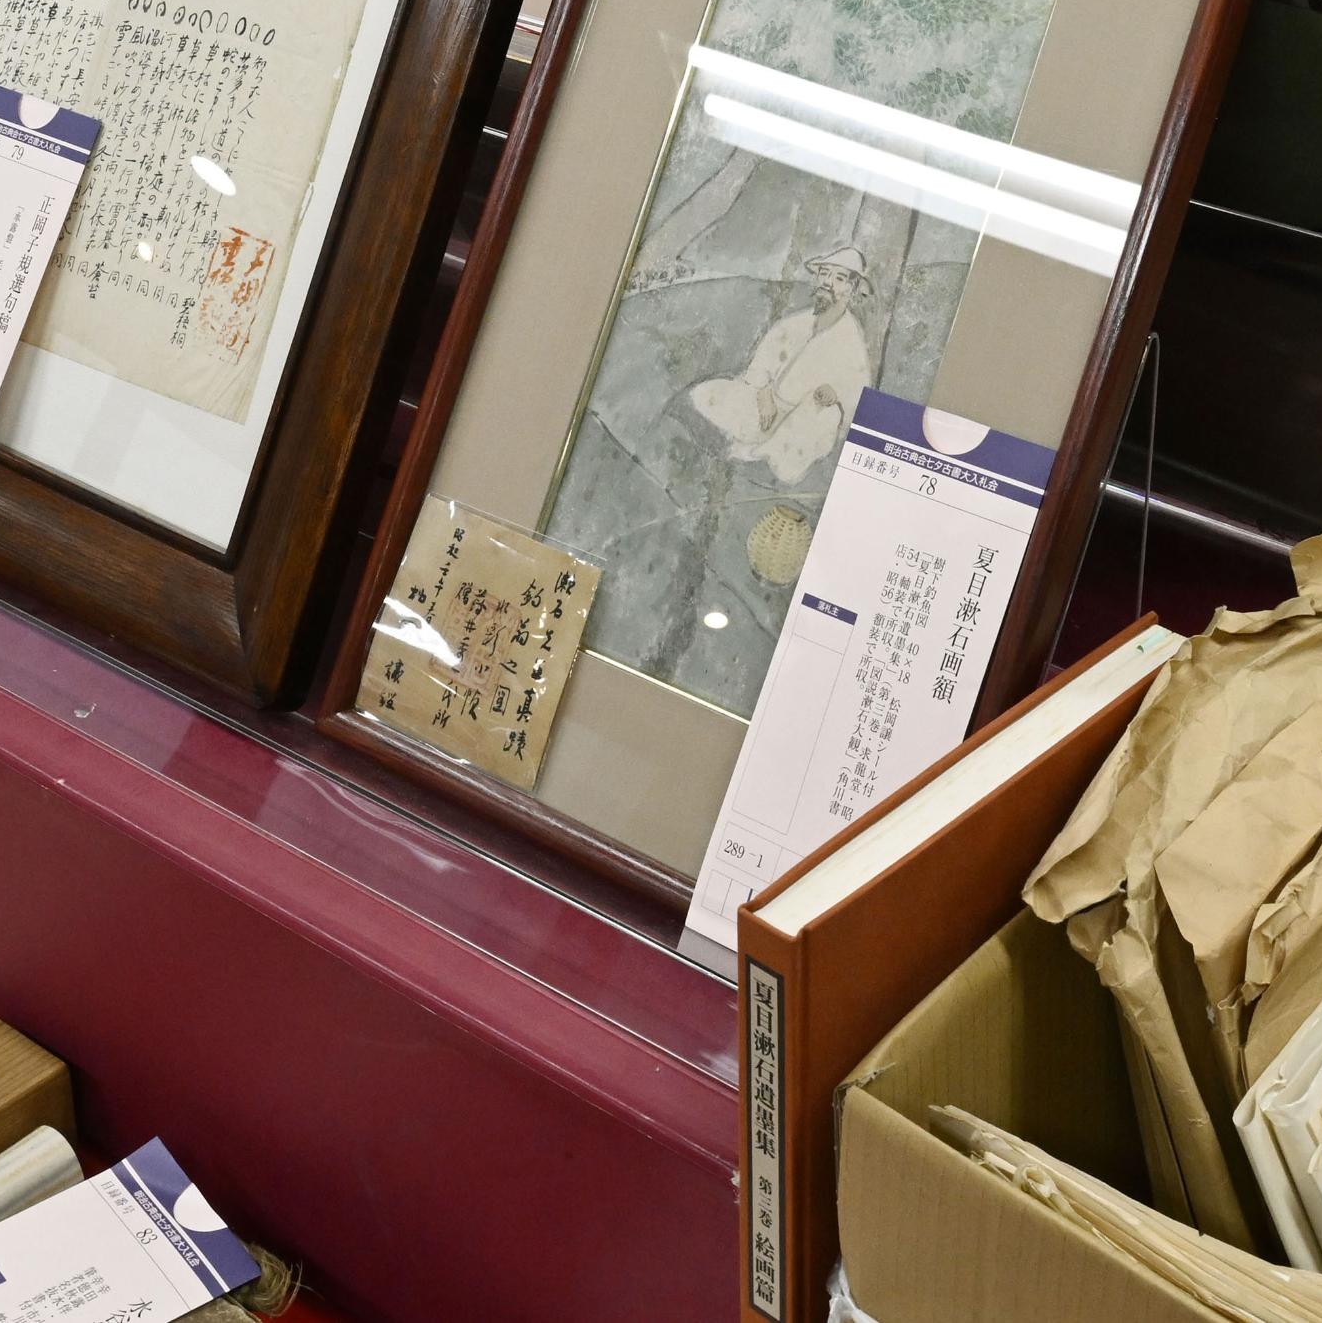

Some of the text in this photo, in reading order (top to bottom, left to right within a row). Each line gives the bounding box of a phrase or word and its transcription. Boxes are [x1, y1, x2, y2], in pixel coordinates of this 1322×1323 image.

[10, 144, 25, 161] 79
[852, 451, 938, 496] 目録番号 78
[883, 441, 999, 492] 明治古典会七夕古書大入札会
[914, 555, 946, 629] 樹下釣魚図
[932, 543, 1000, 706] 夏目漱石画額
[753, 980, 776, 1160] 夏目漱石遺墨集
[100, 1180, 159, 1248] 目録番号 83
[754, 1231, 776, 1306] 絵画篇
